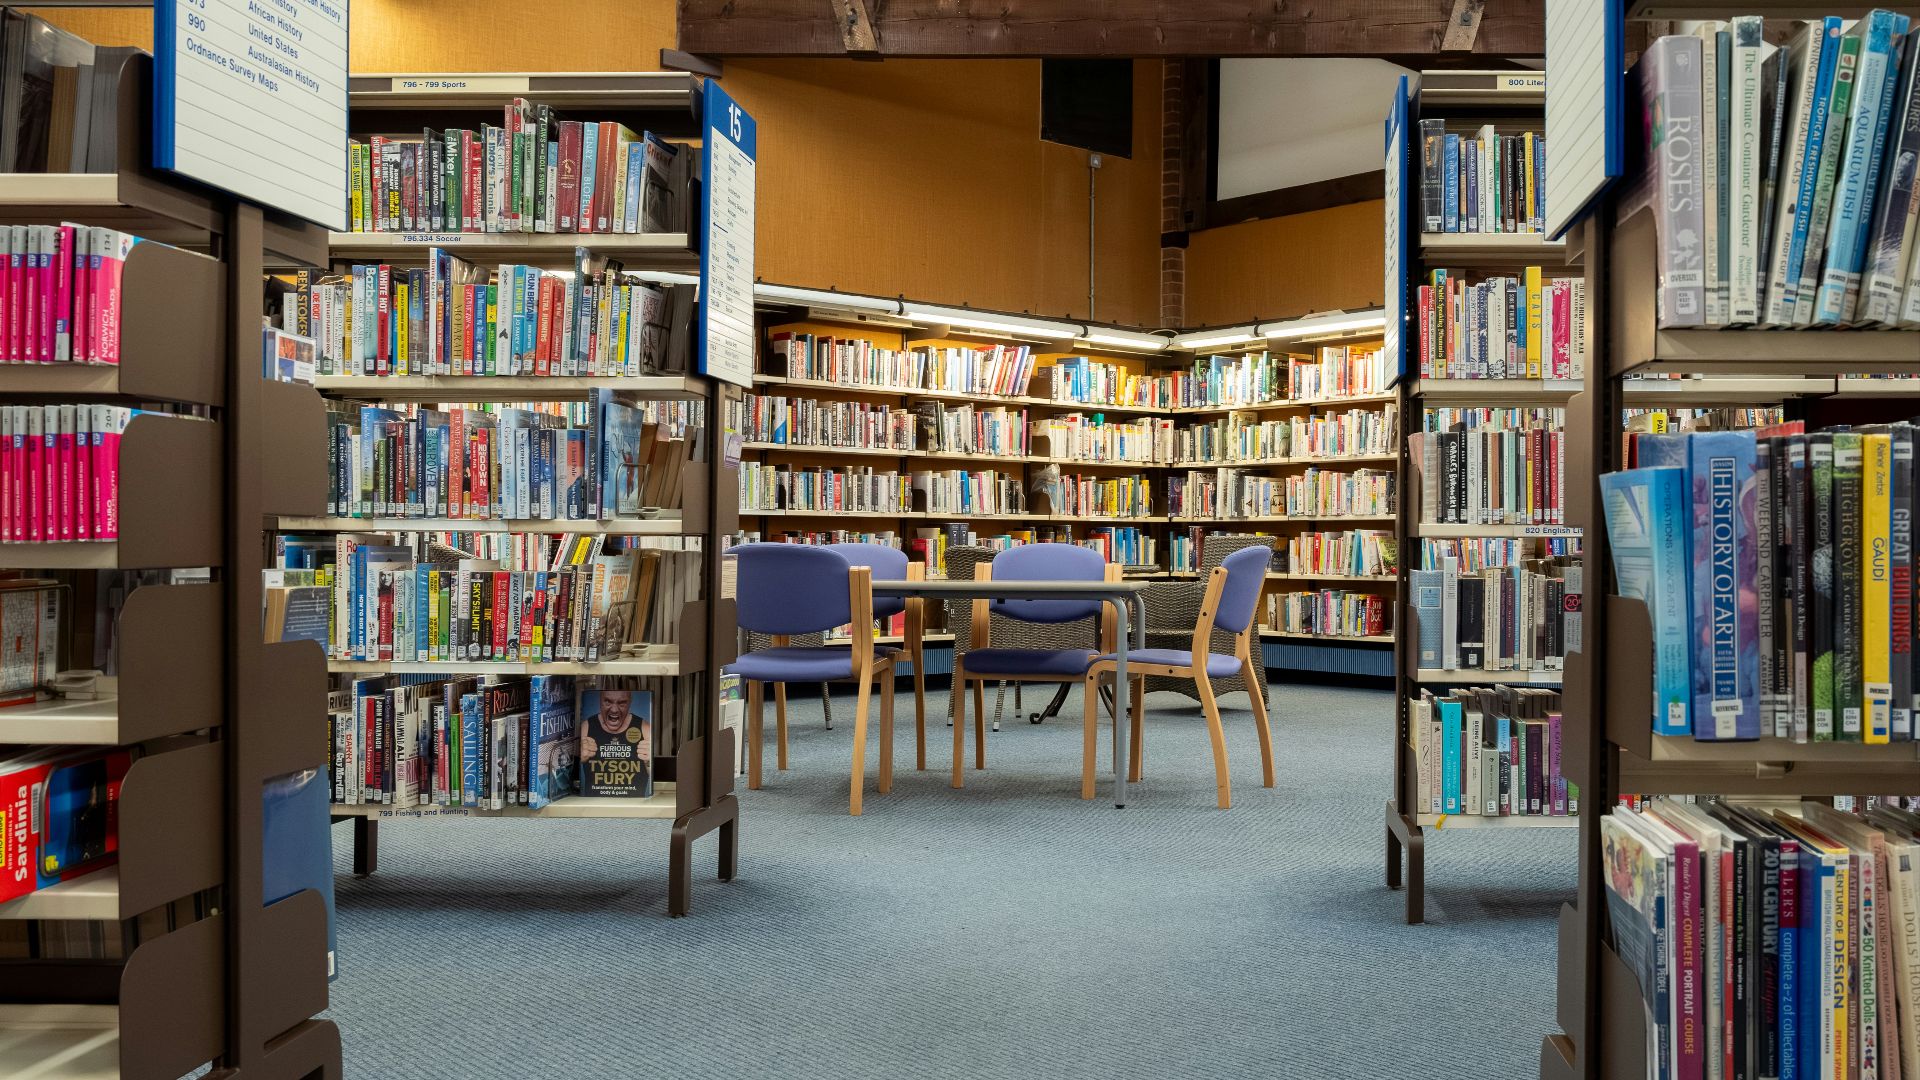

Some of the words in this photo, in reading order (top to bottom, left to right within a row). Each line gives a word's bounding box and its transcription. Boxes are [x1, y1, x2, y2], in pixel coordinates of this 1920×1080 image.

[188, 13, 205, 31] 990
[249, 1, 275, 23] African
[278, 18, 303, 41] History
[249, 23, 273, 45] United
[276, 38, 299, 59] States
[1808, 28, 1823, 73] OWNING
[187, 37, 227, 67] Ordnance
[230, 58, 255, 82] Survey
[259, 75, 278, 92] Maps
[248, 46, 293, 78] Australasian
[296, 71, 319, 93] History
[1744, 50, 1757, 72] The
[1743, 77, 1756, 128] Ultimate
[1802, 75, 1816, 110] HAPPY,
[1878, 76, 1896, 126] TROPICAL
[729, 103, 741, 143] 15
[1796, 113, 1810, 158] HEALTHY
[1812, 96, 1827, 141] TROPICAL
[446, 142, 457, 176] Mixer
[585, 130, 595, 160] HENRY
[1742, 132, 1755, 190] Container
[1821, 124, 1842, 194] AQUARIUM
[1846, 106, 1872, 187] AQUARIUM
[1867, 130, 1885, 186] AQUARIUM
[1667, 116, 1692, 213] ROSES
[1791, 160, 1802, 184] CATS
[1801, 145, 1819, 207] FRESHWATER
[488, 180, 496, 214] Tennis
[581, 176, 593, 215] BLOFELD
[1815, 198, 1829, 226] FISH
[1841, 187, 1857, 220] FISH
[1741, 195, 1753, 246] Gardener
[1797, 209, 1807, 232] FISH
[298, 270, 307, 291] BEN
[312, 292, 320, 302] JOE
[366, 267, 376, 312] Bazball
[379, 270, 387, 295] WHITE
[526, 273, 534, 290] RUN
[298, 295, 307, 336] STOKES
[312, 304, 321, 320] ROOT
[379, 298, 388, 313] HOT
[454, 304, 462, 321] MO
[526, 292, 534, 321] BRITAIN
[1531, 294, 1540, 329] CATS
[454, 323, 462, 357] FARAH
[540, 314, 548, 342] RUNNERS
[427, 454, 436, 487] ROVER
[1449, 441, 1457, 472] CHARLES
[1876, 443, 1886, 468] Rainer
[1449, 473, 1457, 508] BUKOWSKI
[1760, 478, 1768, 495] THE
[1876, 471, 1886, 496] Zerbst
[1664, 482, 1674, 548] OPERATIONS
[1713, 474, 1733, 571] HISTORY
[1816, 469, 1831, 546] Contemporary
[1759, 497, 1771, 558] WEEKEND
[1840, 480, 1853, 580] HIGHGROVE
[1892, 509, 1909, 562] GREAT
[1873, 537, 1888, 582] GAUDÍ
[472, 583, 481, 606] SKY'S
[595, 563, 605, 592] AFRICA
[1665, 551, 1676, 617] MANAGEMENT
[1714, 574, 1734, 602] OF
[1797, 565, 1805, 592] Islamic
[1760, 565, 1772, 638] CARPENTER
[1797, 594, 1806, 606] Art
[1892, 566, 1910, 653] BUILDINGS
[472, 609, 481, 632] LIMIT
[1715, 603, 1734, 648] ART
[1795, 615, 1806, 641] Design
[375, 701, 383, 716] JOHN
[540, 713, 574, 737] FISHING
[375, 718, 383, 749] KAVANAGH
[336, 752, 344, 766] Guy
[396, 745, 404, 761] ALI
[464, 722, 476, 786] SAILING
[589, 760, 641, 773] TYSON
[594, 773, 636, 785] FURY
[396, 809, 422, 818] Fishing
[424, 808, 437, 816] and
[440, 808, 469, 816] Hunting
[15, 785, 28, 882] Sardinia
[1683, 858, 1692, 890] Reader's
[1737, 864, 1743, 875] to
[1764, 849, 1778, 884] 20TH
[1682, 891, 1692, 917] Digest
[1823, 890, 1832, 915] BRITISH
[1849, 865, 1857, 909] LEATHER
[1763, 887, 1778, 955] CENTURY
[1823, 917, 1832, 936] ROYAL
[1835, 920, 1844, 934] OF
[1849, 912, 1857, 959] JEWELRY
[1878, 913, 1888, 947] HOUSE
[1903, 911, 1918, 960] DOLLS'
[1656, 928, 1665, 965] SKETCHING
[1683, 918, 1693, 967] COMPLETE
[1782, 932, 1794, 980] complete
[1862, 938, 1874, 952] 50
[1657, 967, 1666, 993] PEOPLE
[1735, 965, 1743, 983] simple
[1823, 937, 1832, 997] COMMEMORATIVES
[1834, 940, 1846, 1009] DESIGN
[1862, 955, 1875, 995] Knitted
[1684, 969, 1694, 1015] PORTRAIT
[1909, 963, 1920, 1009] HOUSE
[1783, 1004, 1794, 1016] of
[1849, 1000, 1857, 1024] LINDA
[1863, 998, 1875, 1024] Dolls
[1684, 1017, 1694, 1055] COURSE
[1783, 1017, 1794, 1080] collectables
[1849, 1026, 1857, 1067] PETERSON
